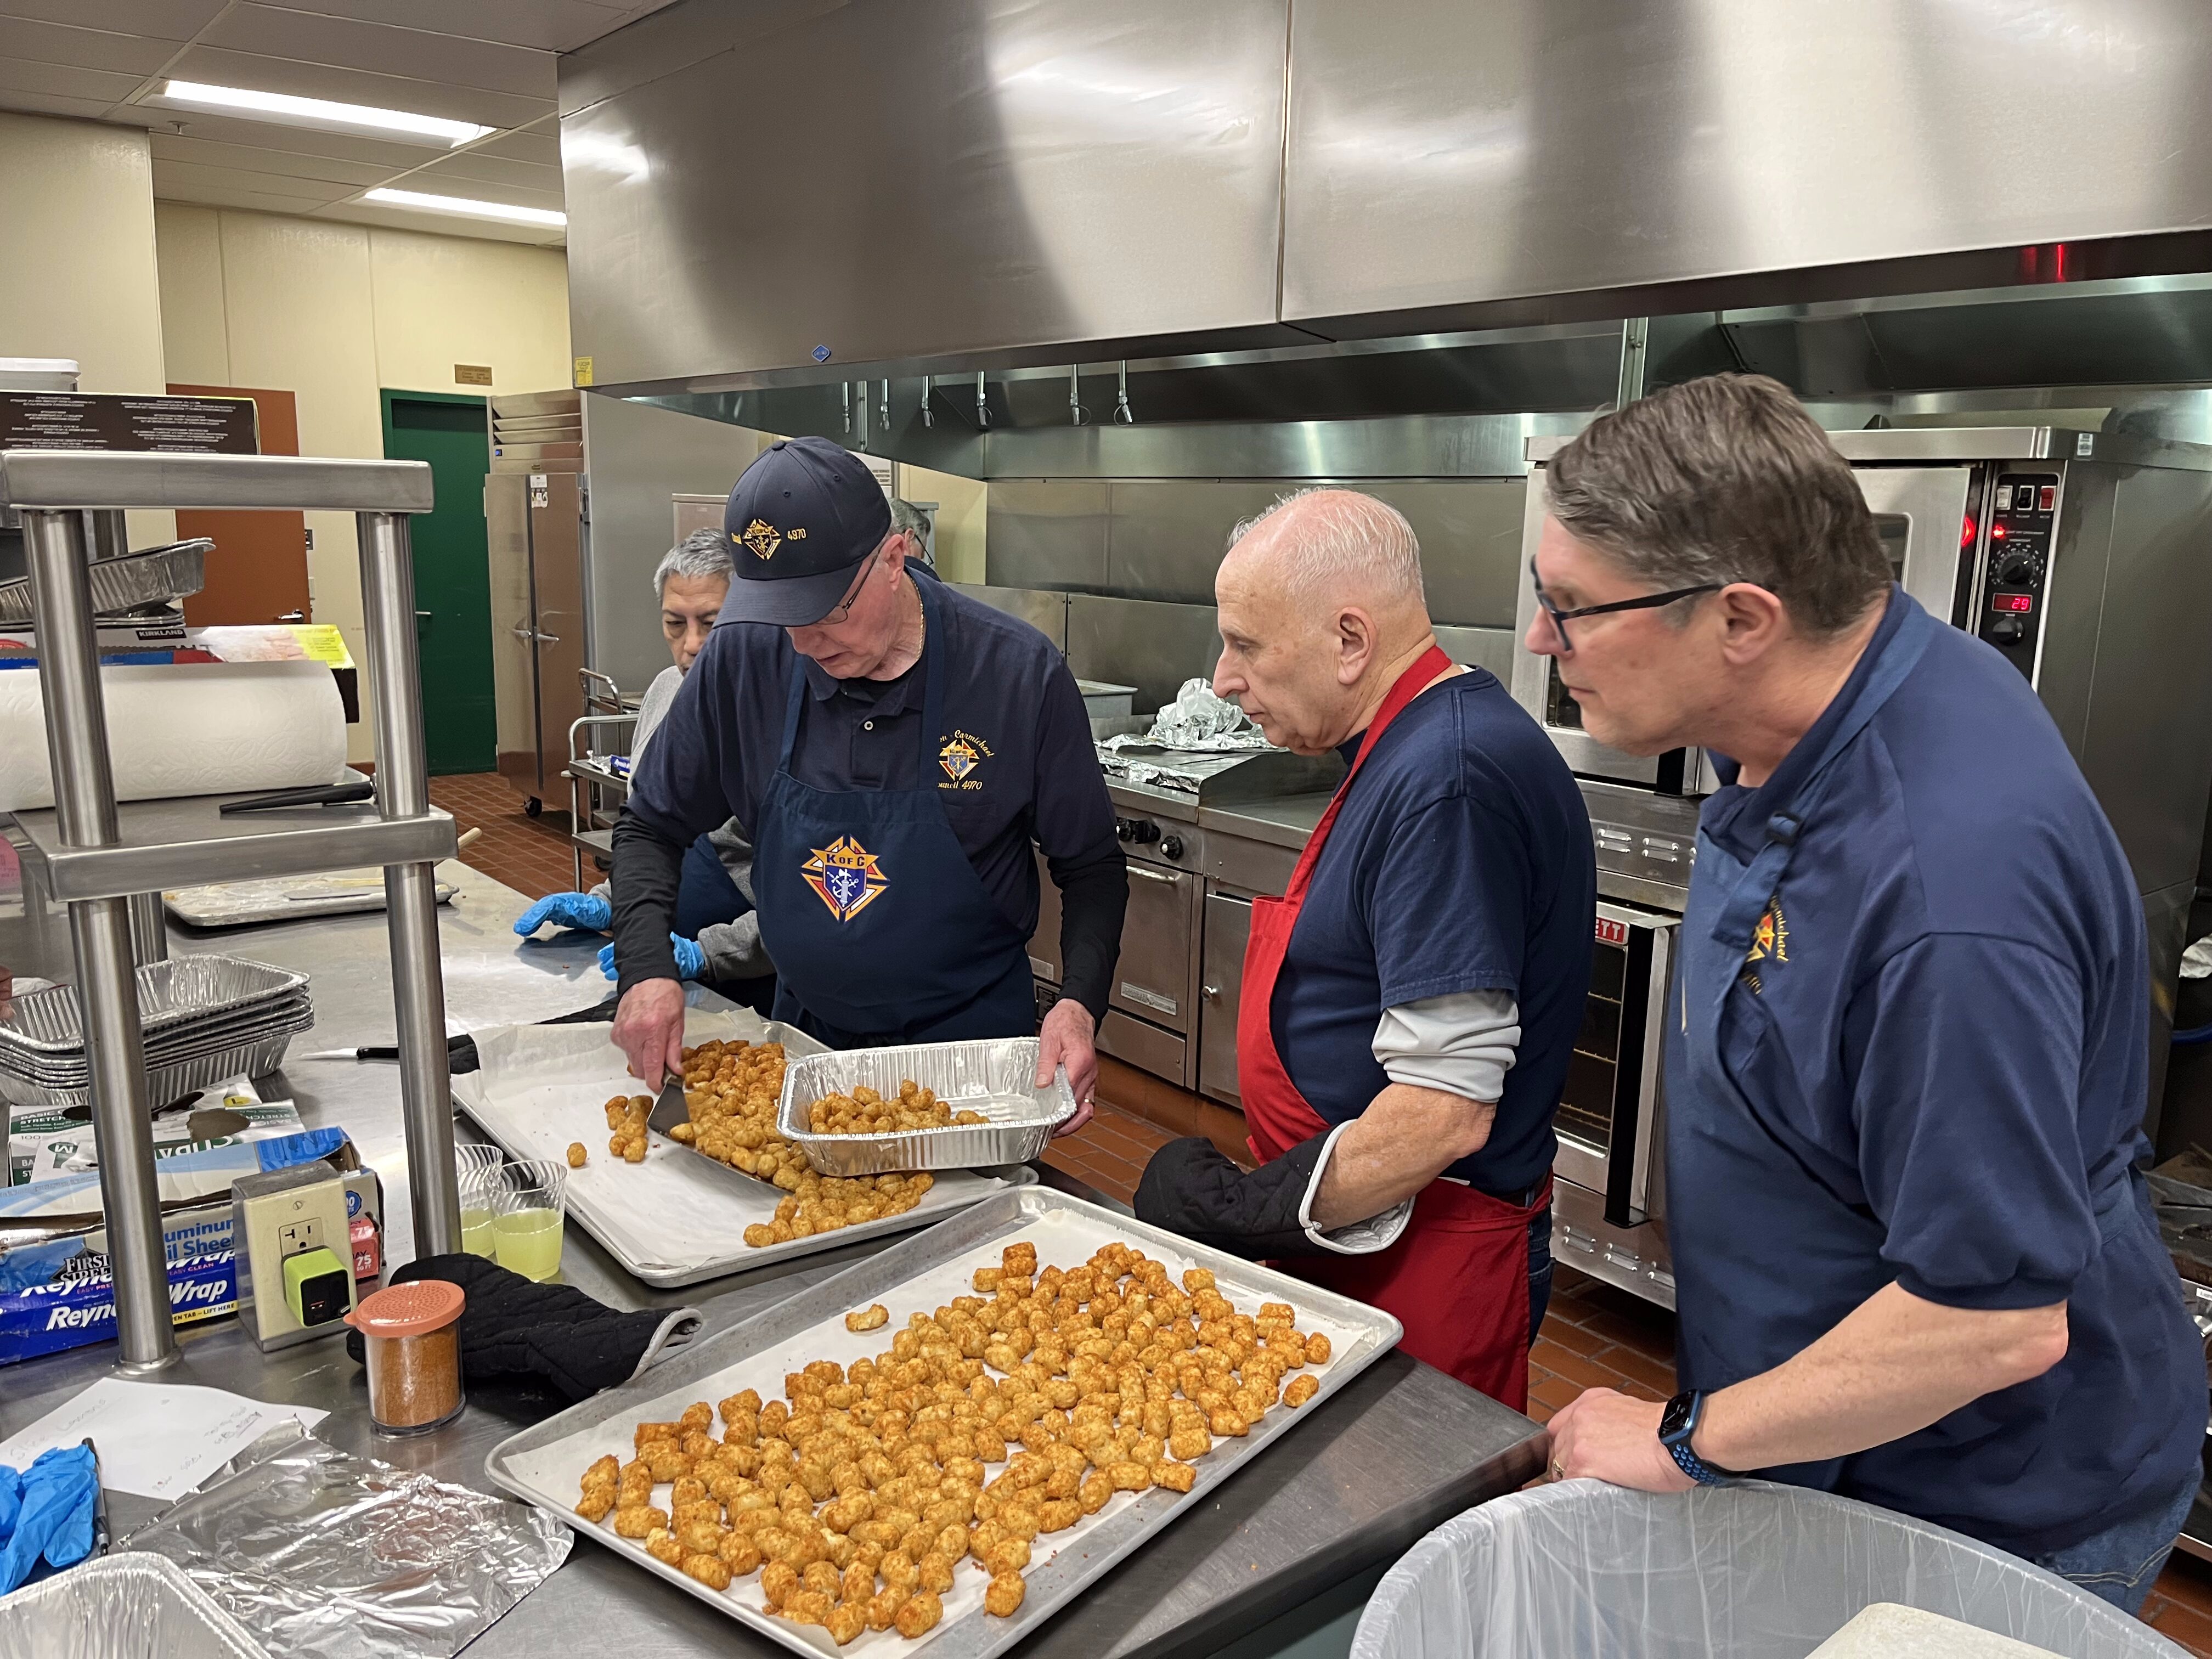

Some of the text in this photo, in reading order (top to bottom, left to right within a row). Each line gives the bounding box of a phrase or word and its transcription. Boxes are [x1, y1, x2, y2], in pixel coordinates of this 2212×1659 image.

[787, 528, 806, 540] 4970
[955, 729, 995, 758] Carmichael
[961, 780, 983, 790] 4970
[826, 854, 837, 864] K
[857, 856, 865, 866] C
[20, 1116, 66, 1125] STRETCH
[21, 1111, 54, 1120] BASIC
[66, 1255, 110, 1273] FIRST
[356, 1255, 372, 1266] 75
[188, 1263, 214, 1271] CLEAN
[168, 1280, 227, 1305] Wrap
[218, 1303, 235, 1312] HERE
